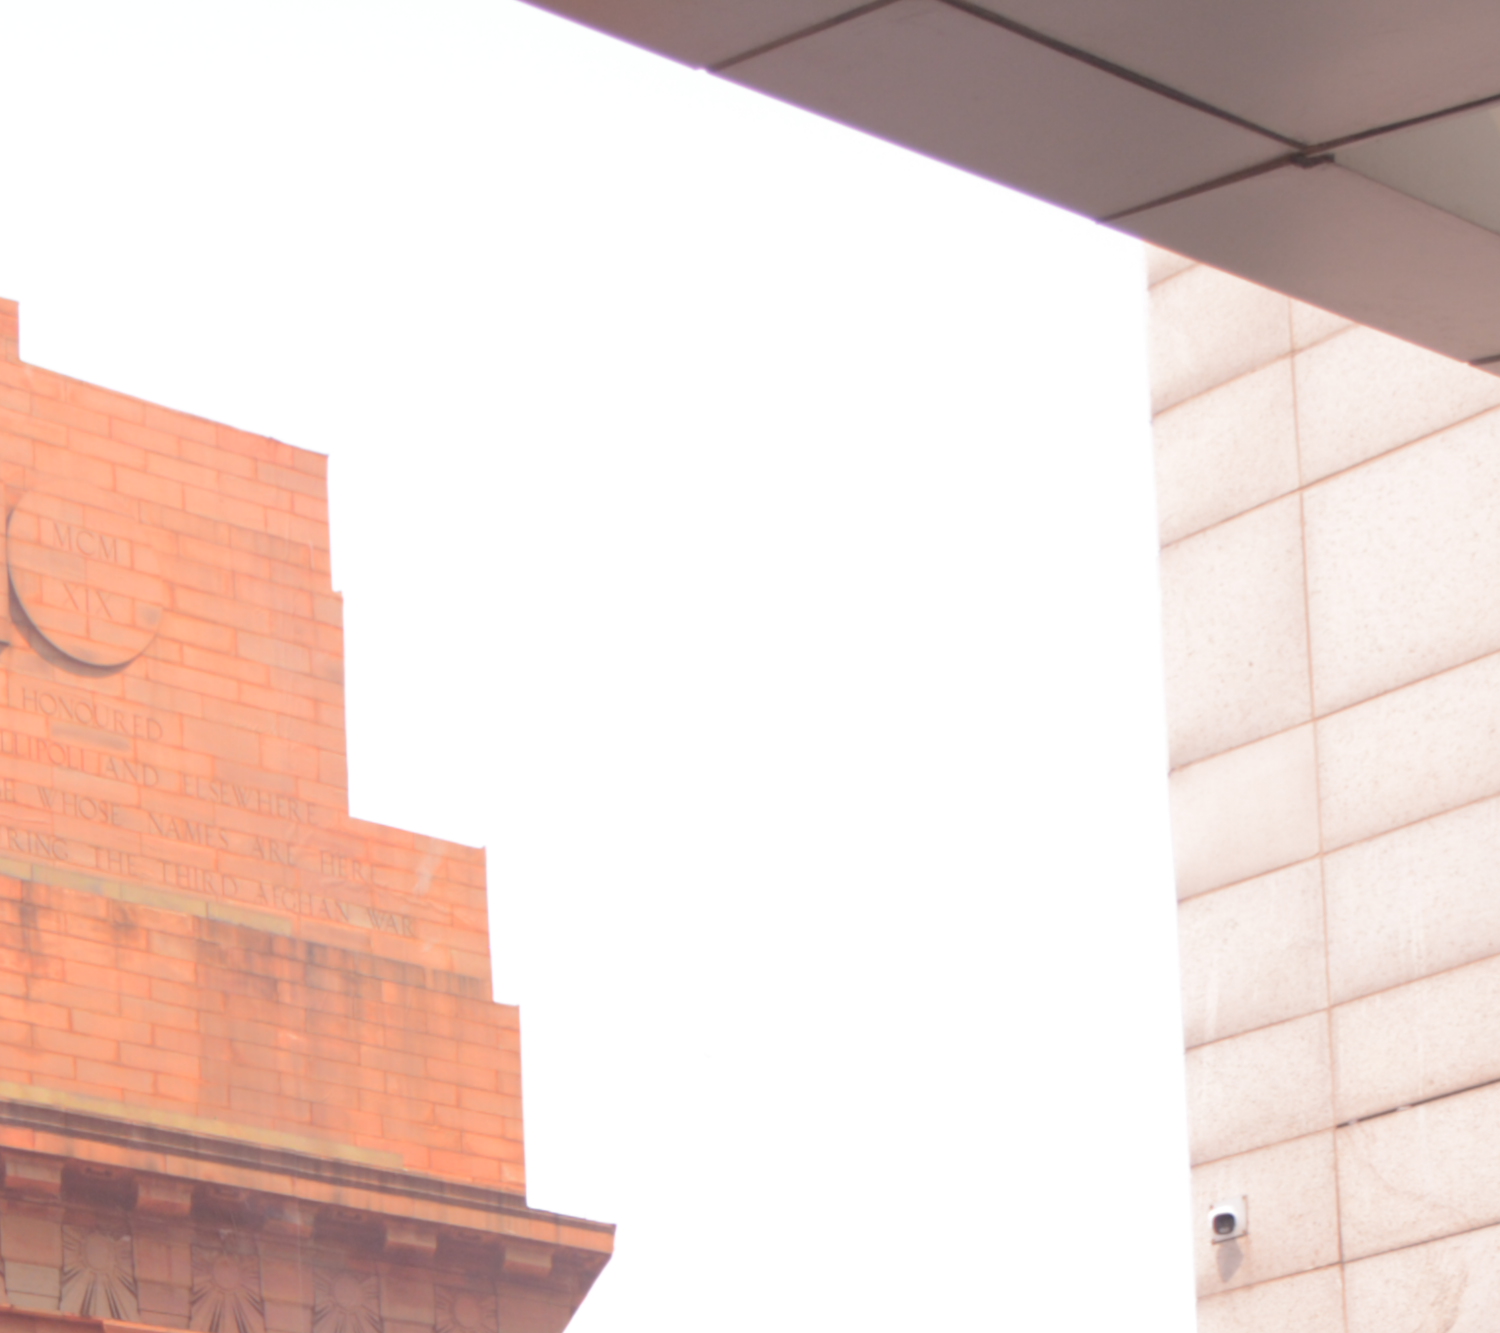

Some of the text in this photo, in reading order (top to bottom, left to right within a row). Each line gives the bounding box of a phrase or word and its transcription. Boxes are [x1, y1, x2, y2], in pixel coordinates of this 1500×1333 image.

[52, 520, 118, 566] MCM
[62, 581, 114, 621] XIX
[21, 687, 163, 744] HONOURED
[104, 755, 158, 790] AND
[184, 774, 314, 827] ELSEWHERE
[36, 787, 116, 827] WHOSE
[148, 813, 228, 854] NAMES
[250, 835, 296, 868] ARE
[94, 845, 137, 879] THE
[161, 861, 237, 902] THIRD
[365, 906, 417, 942] WAR
